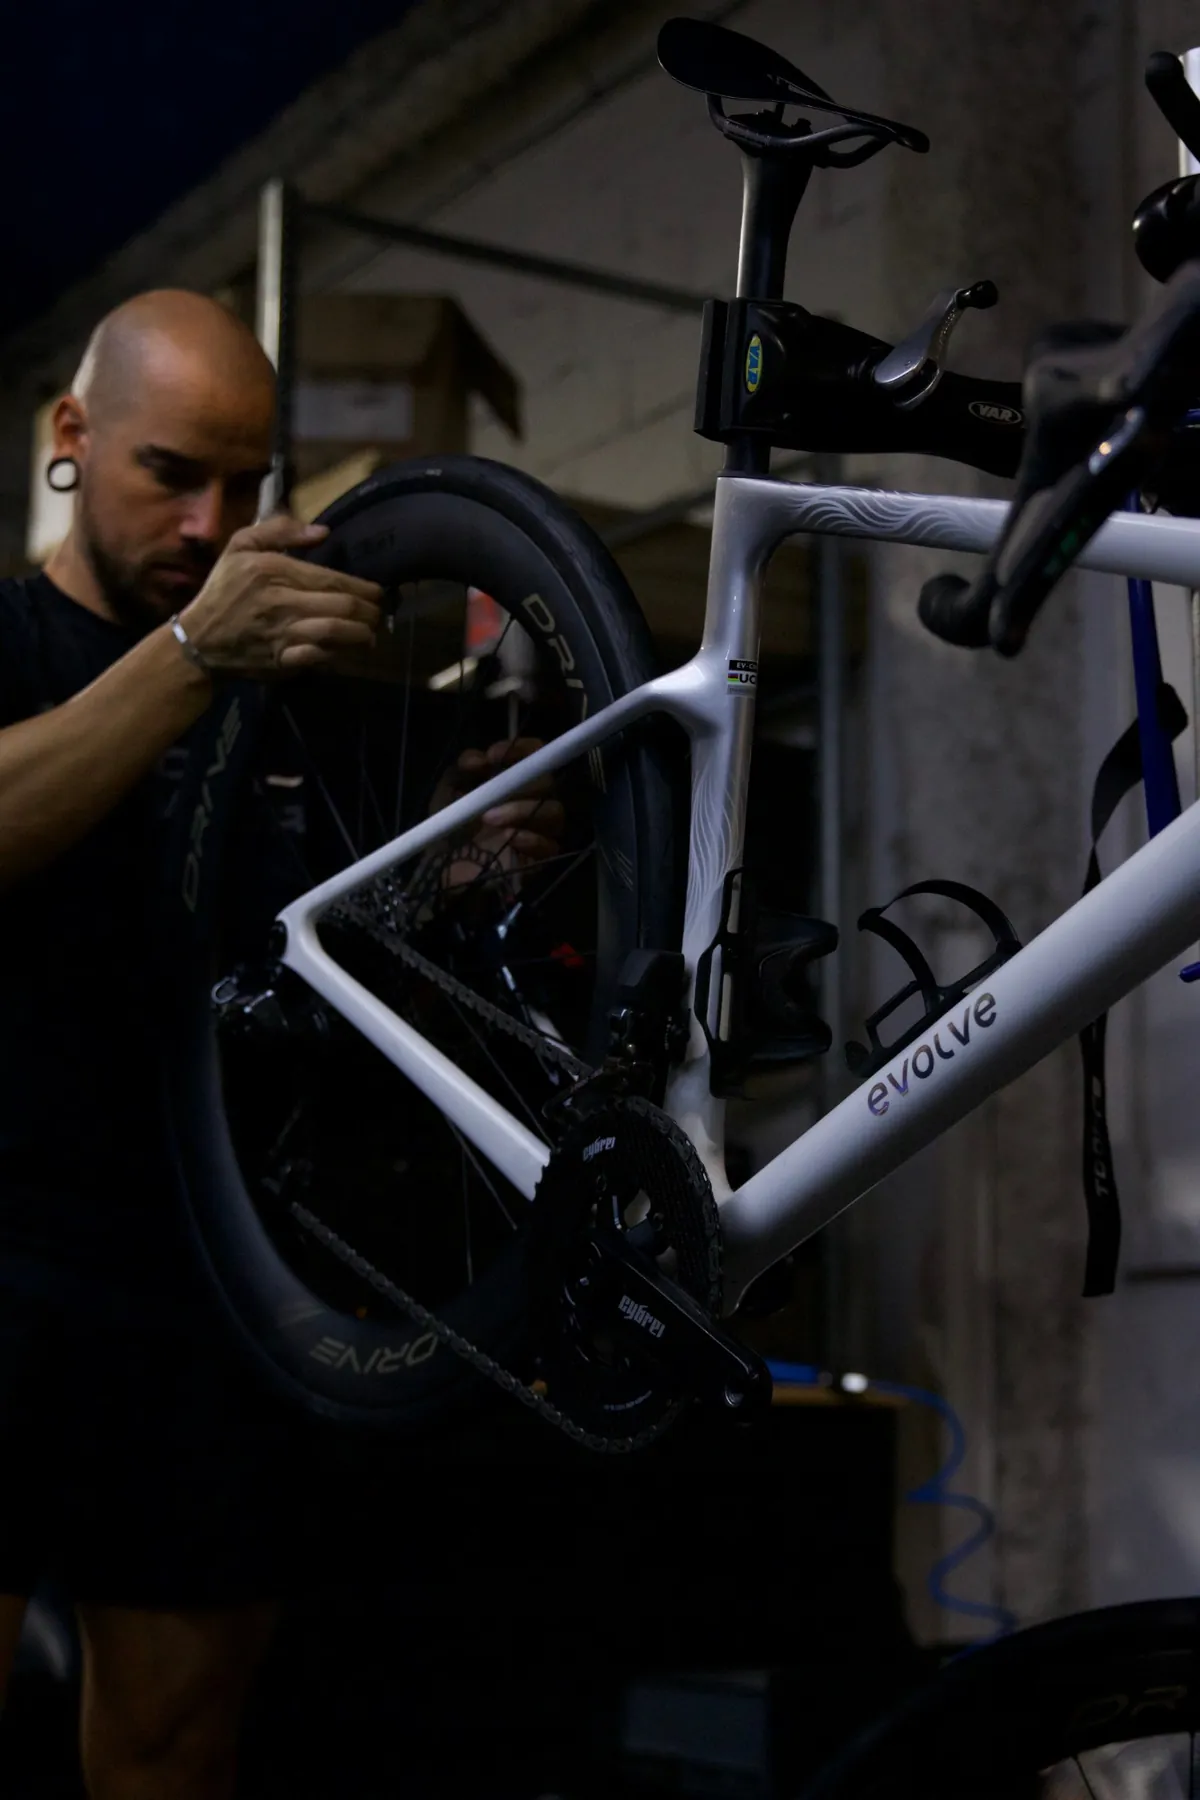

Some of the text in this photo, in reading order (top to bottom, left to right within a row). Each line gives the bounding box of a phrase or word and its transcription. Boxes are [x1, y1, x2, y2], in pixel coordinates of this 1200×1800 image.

[748, 346, 759, 384] VAR
[975, 403, 1013, 421] VAR
[867, 993, 997, 1116] evolve
[618, 1294, 666, 1338] cybrei
[308, 1332, 439, 1374] DRIVE
